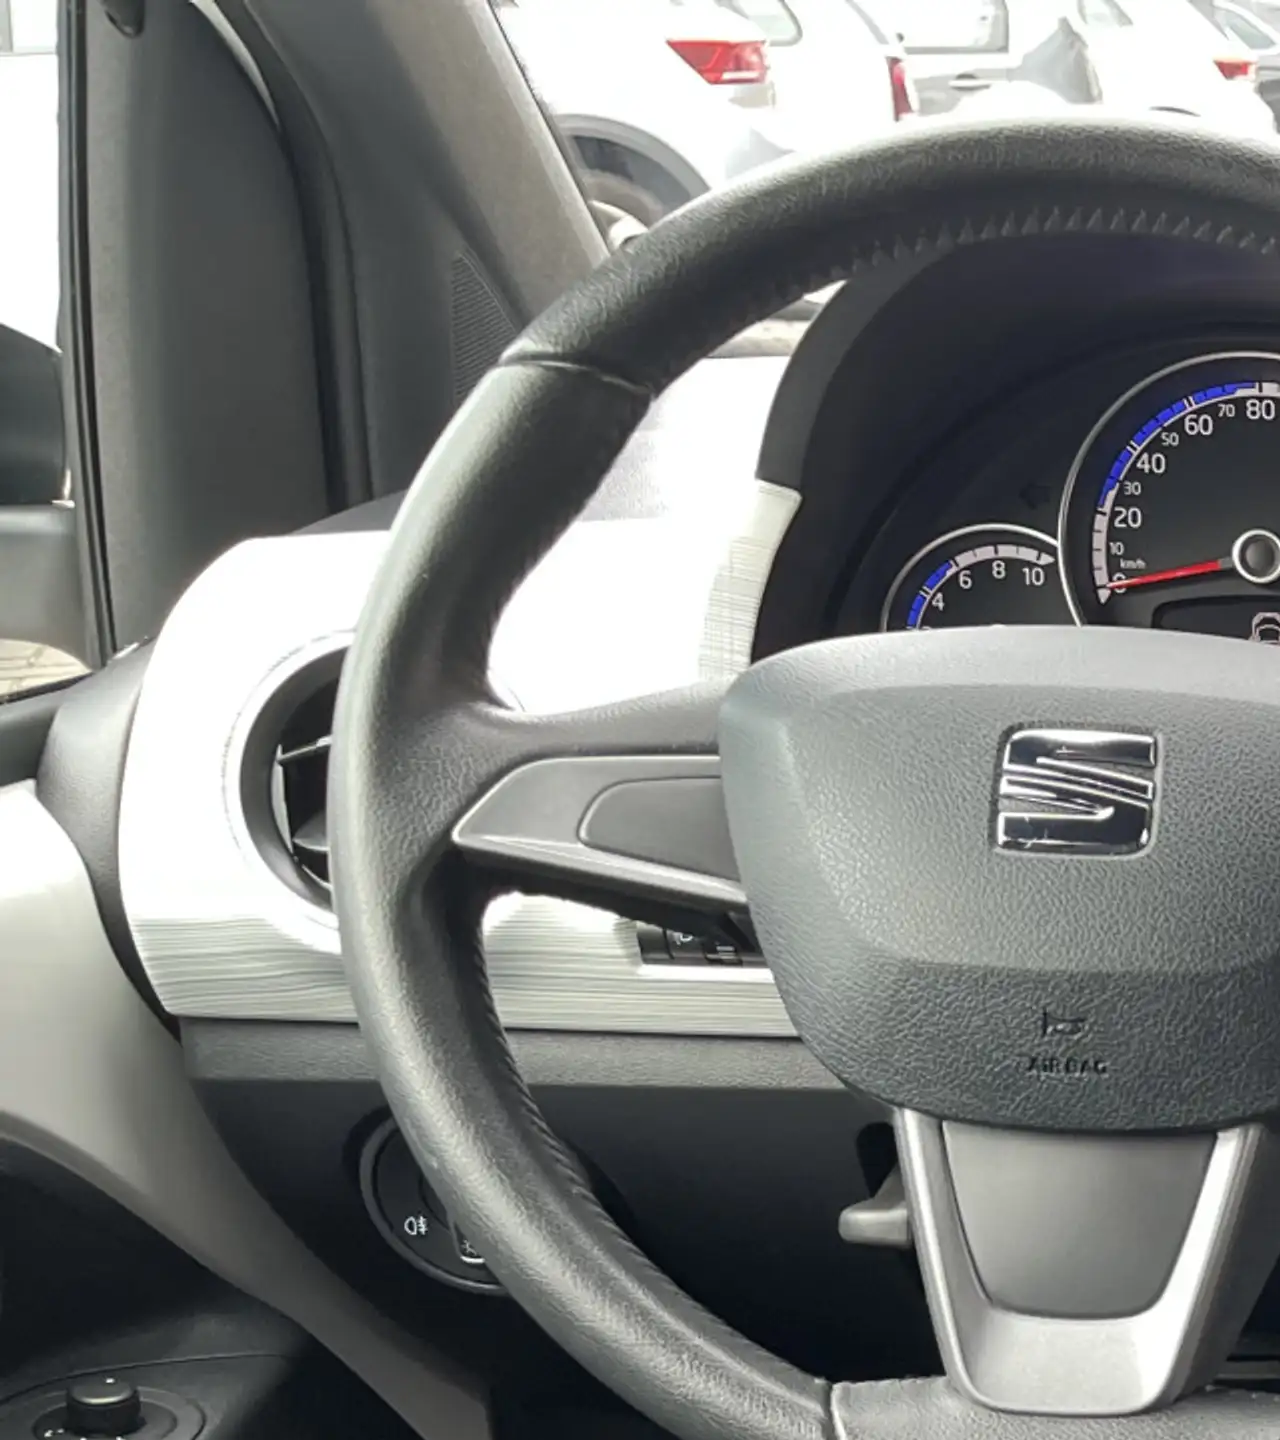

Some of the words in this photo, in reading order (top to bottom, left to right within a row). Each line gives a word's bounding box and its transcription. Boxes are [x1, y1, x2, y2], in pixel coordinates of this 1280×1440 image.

[1218, 404, 1236, 417] 70
[1246, 400, 1276, 420] 80
[1184, 414, 1214, 436] 60
[1161, 431, 1180, 446] 50
[1136, 453, 1166, 474] 40
[1123, 481, 1142, 495] 30
[1113, 507, 1142, 528] 20
[1109, 542, 1125, 555] 10
[991, 560, 1006, 579] 8
[1022, 567, 1045, 586] 10
[959, 570, 973, 589] 6
[931, 592, 945, 611] 4
